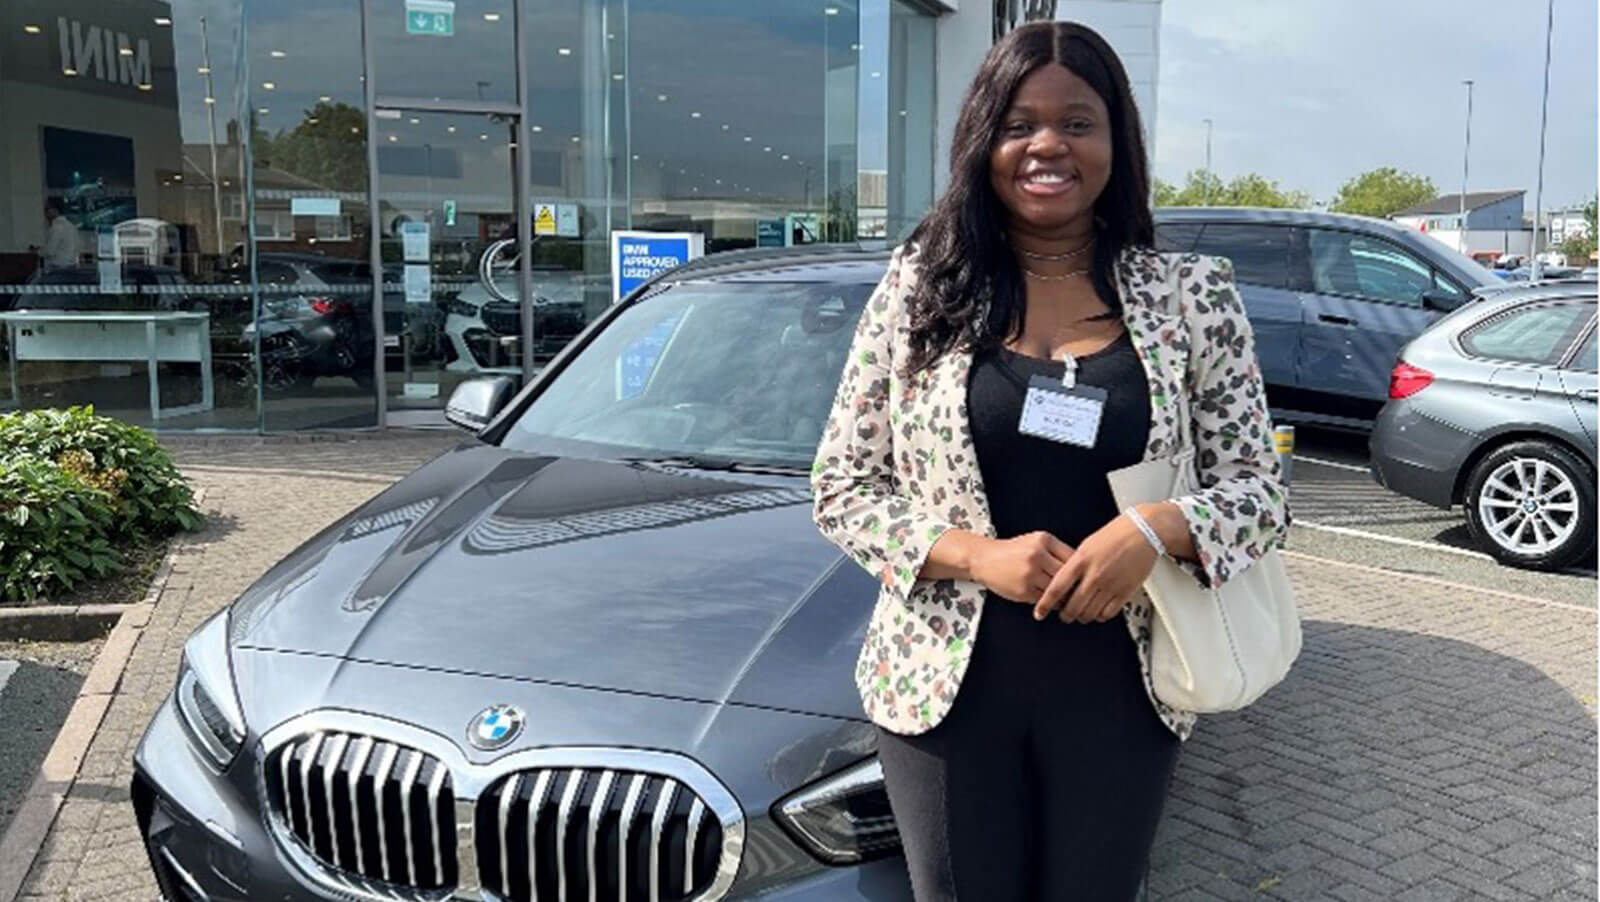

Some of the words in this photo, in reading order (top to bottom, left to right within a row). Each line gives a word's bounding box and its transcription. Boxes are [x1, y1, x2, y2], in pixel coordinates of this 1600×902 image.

[623, 244, 649, 255] BMW
[623, 256, 679, 268] APPROVED
[623, 268, 650, 278] USED
